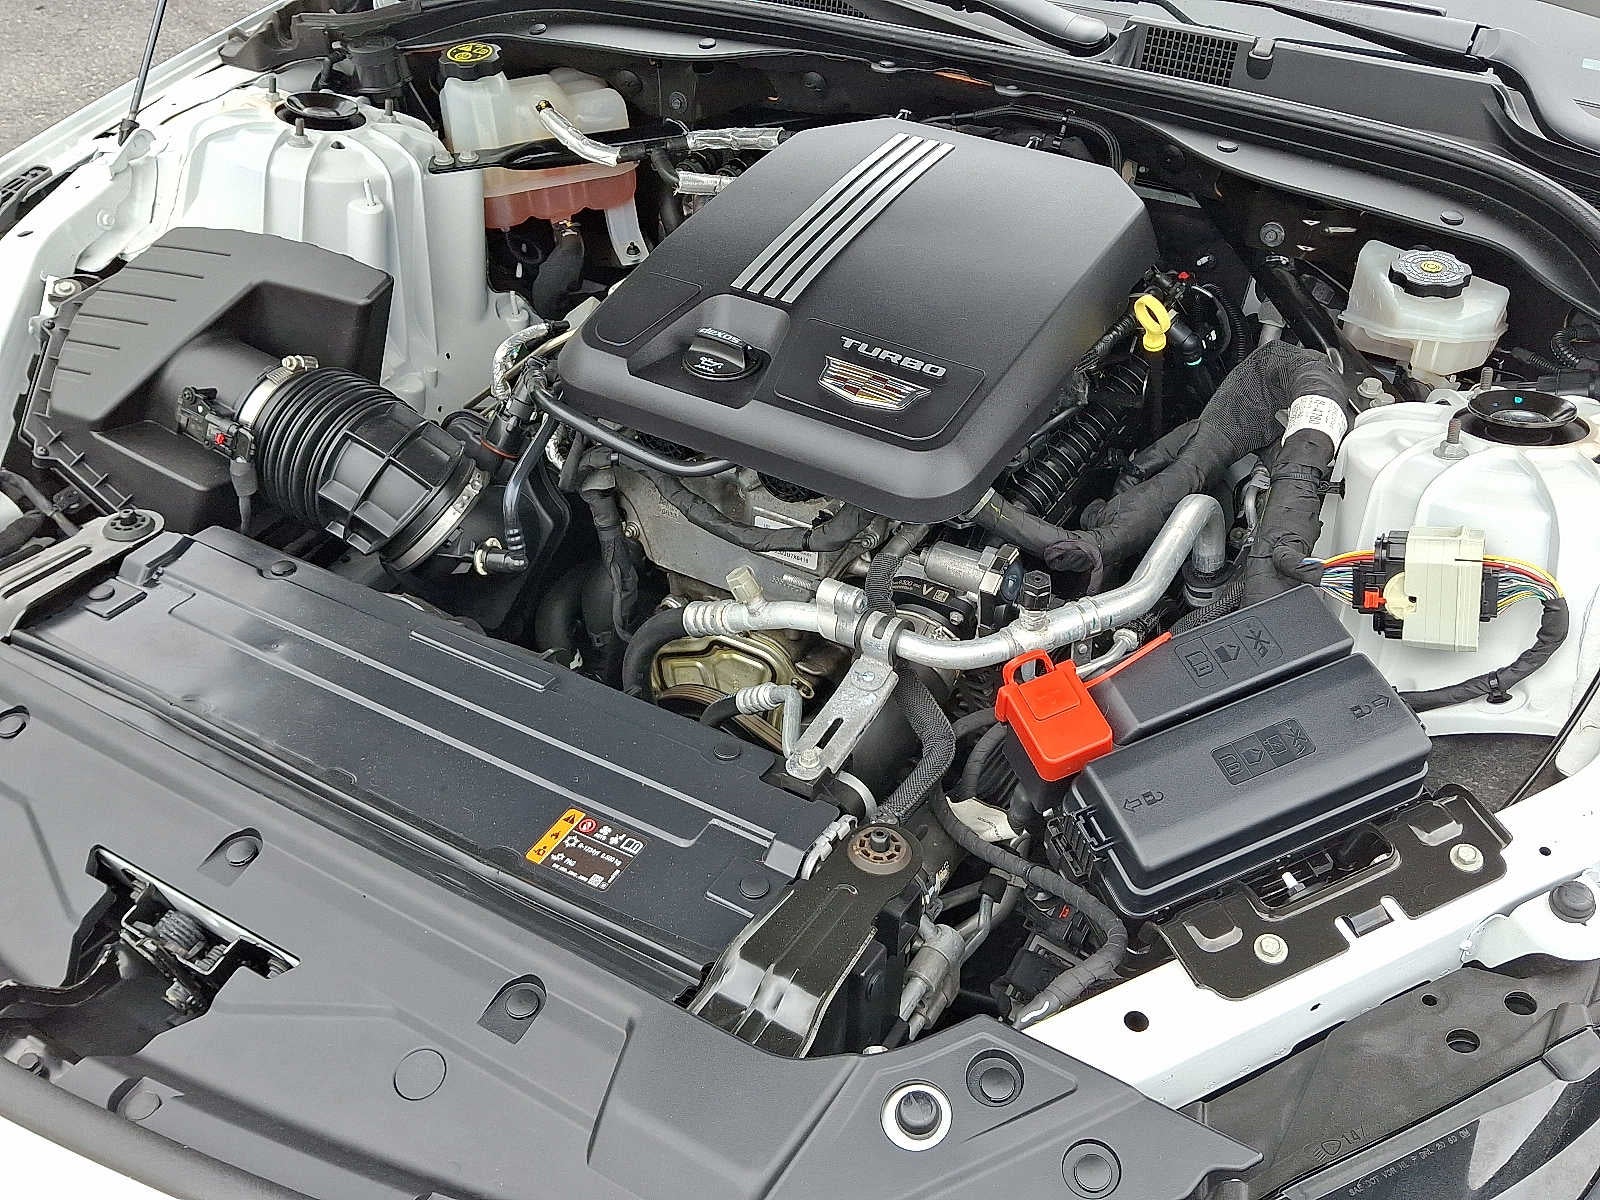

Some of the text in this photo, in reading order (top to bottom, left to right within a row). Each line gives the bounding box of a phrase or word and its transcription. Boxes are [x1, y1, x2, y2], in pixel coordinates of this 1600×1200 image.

[699, 326, 742, 345] dexos
[840, 335, 947, 378] TURBO
[1348, 1182, 1364, 1197] SAE
[1366, 1174, 1380, 1188] DOT
